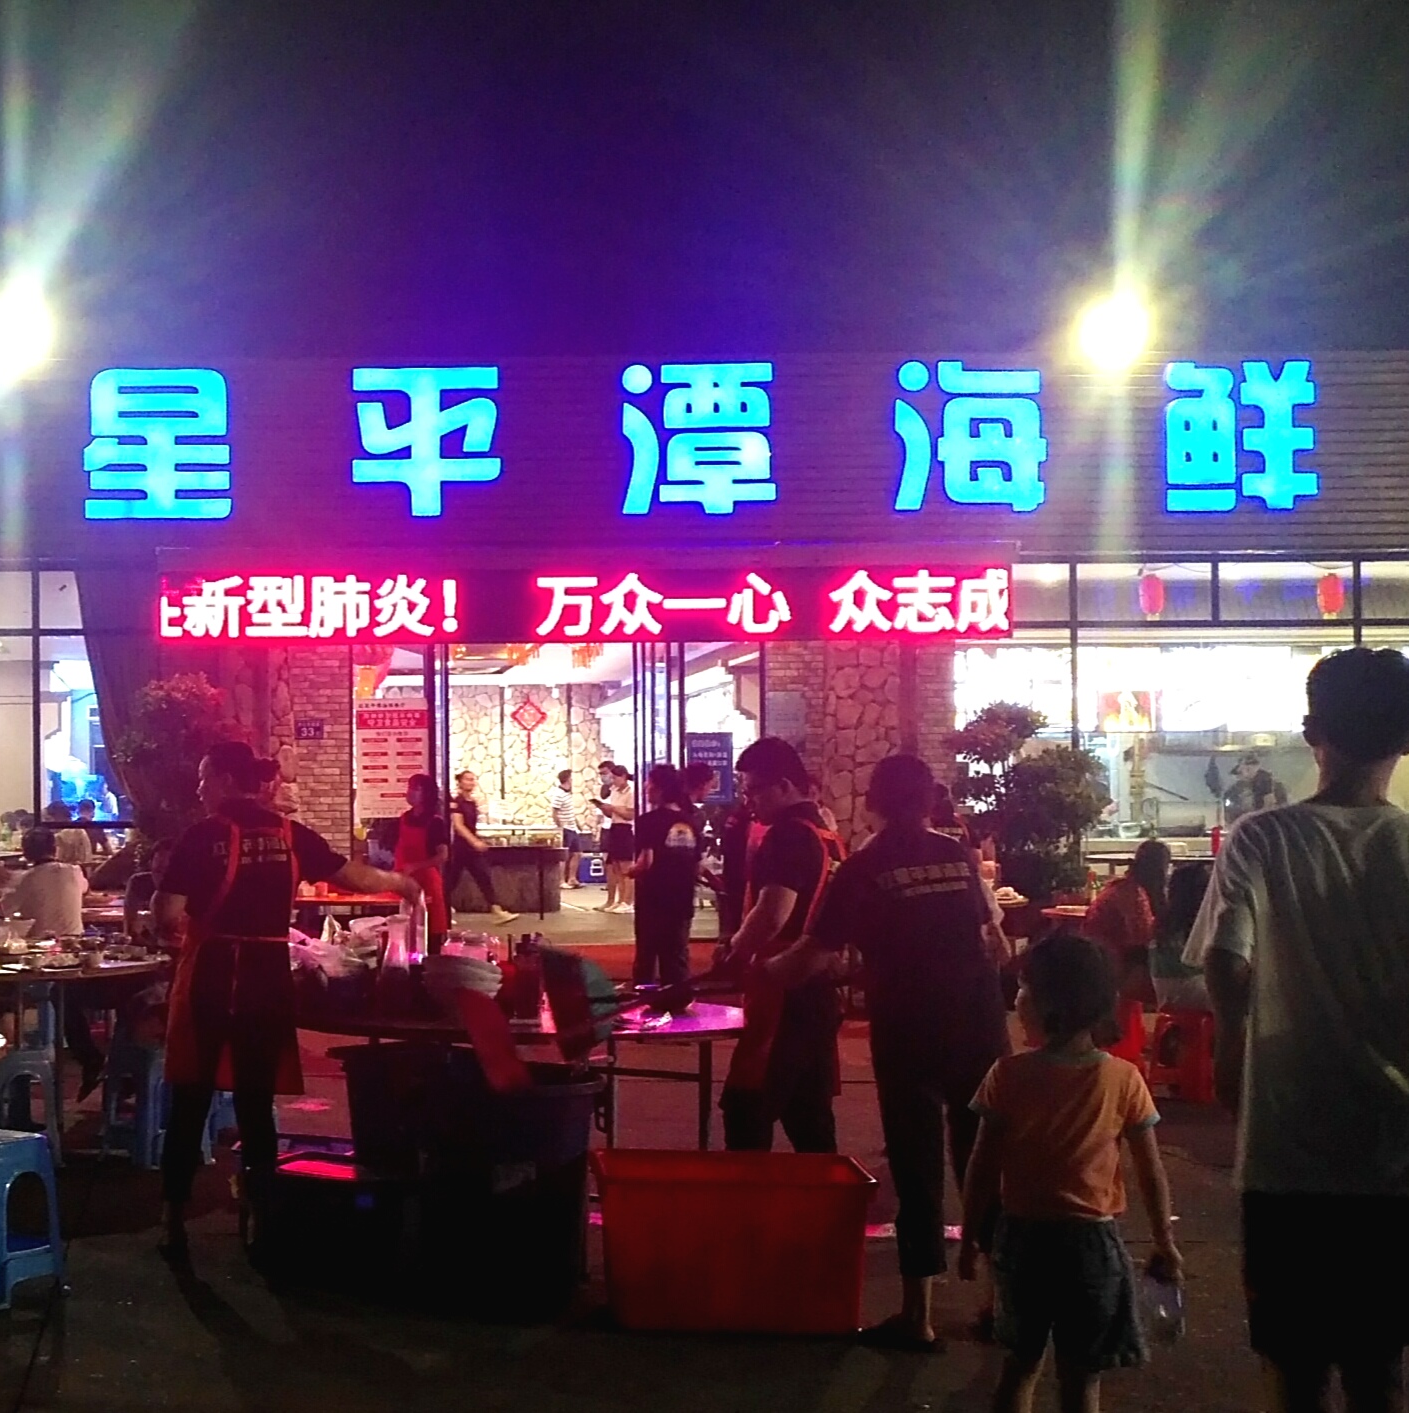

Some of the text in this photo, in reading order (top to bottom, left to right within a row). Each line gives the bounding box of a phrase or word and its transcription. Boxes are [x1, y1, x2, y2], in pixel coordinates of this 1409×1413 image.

[536, 572, 791, 636] 万众一心
[829, 568, 1009, 633] 众志成
